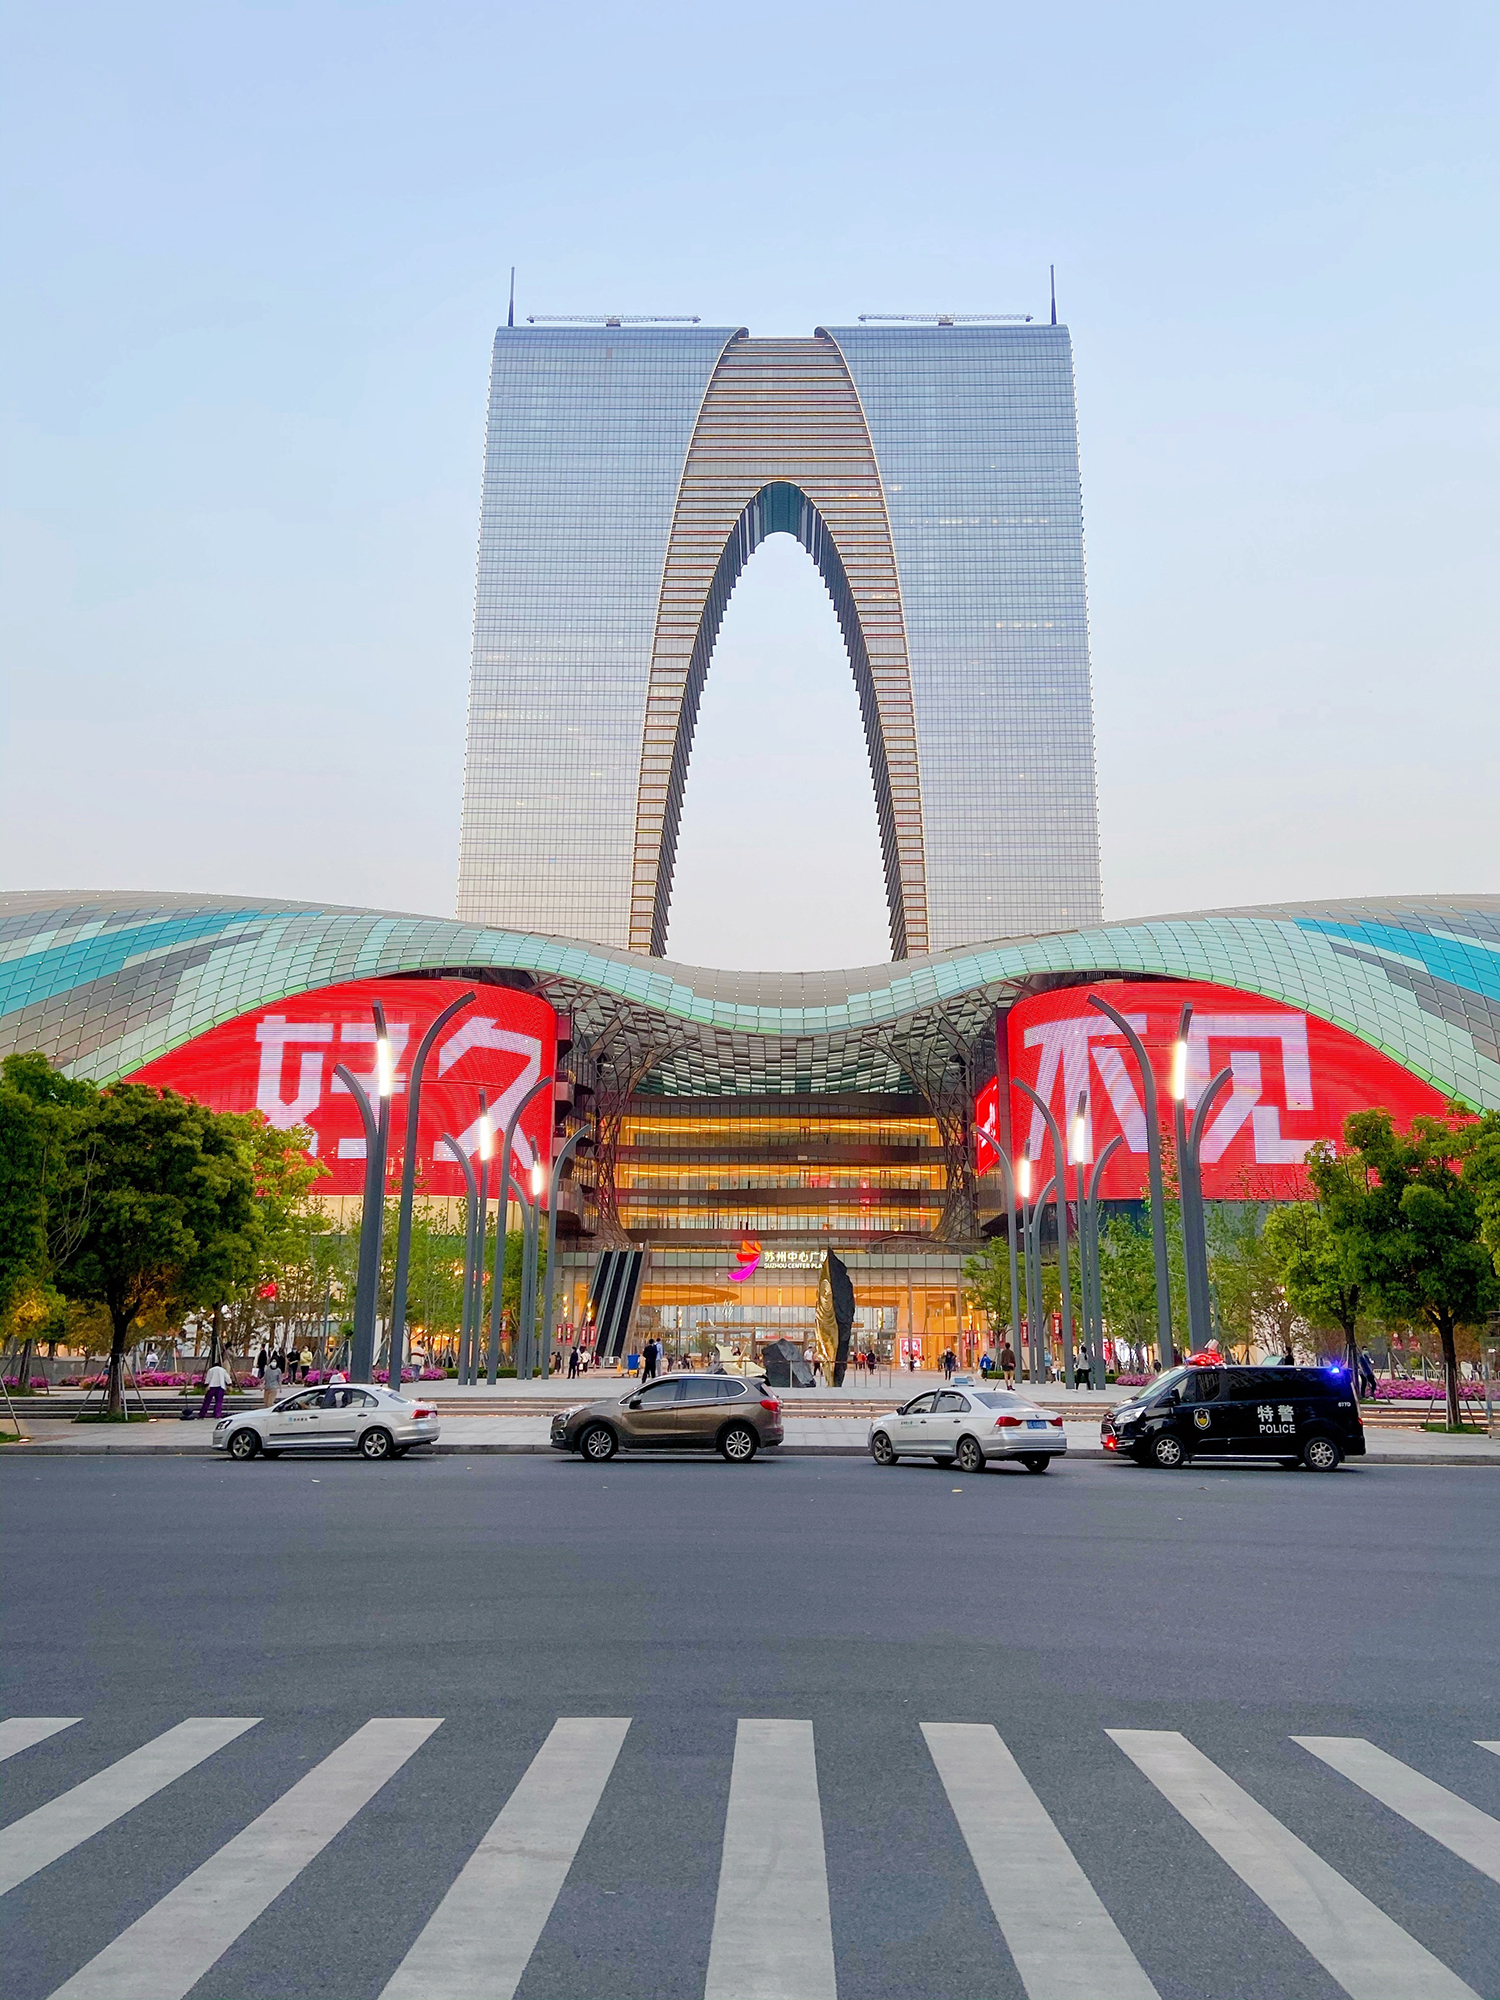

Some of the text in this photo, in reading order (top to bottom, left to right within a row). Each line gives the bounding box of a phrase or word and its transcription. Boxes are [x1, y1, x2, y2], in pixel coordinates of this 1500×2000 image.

[255, 1015, 542, 1170] 好久
[1024, 1014, 1335, 1165] 不见
[1257, 1404, 1295, 1422] 特警
[1259, 1424, 1296, 1434] POLICE
